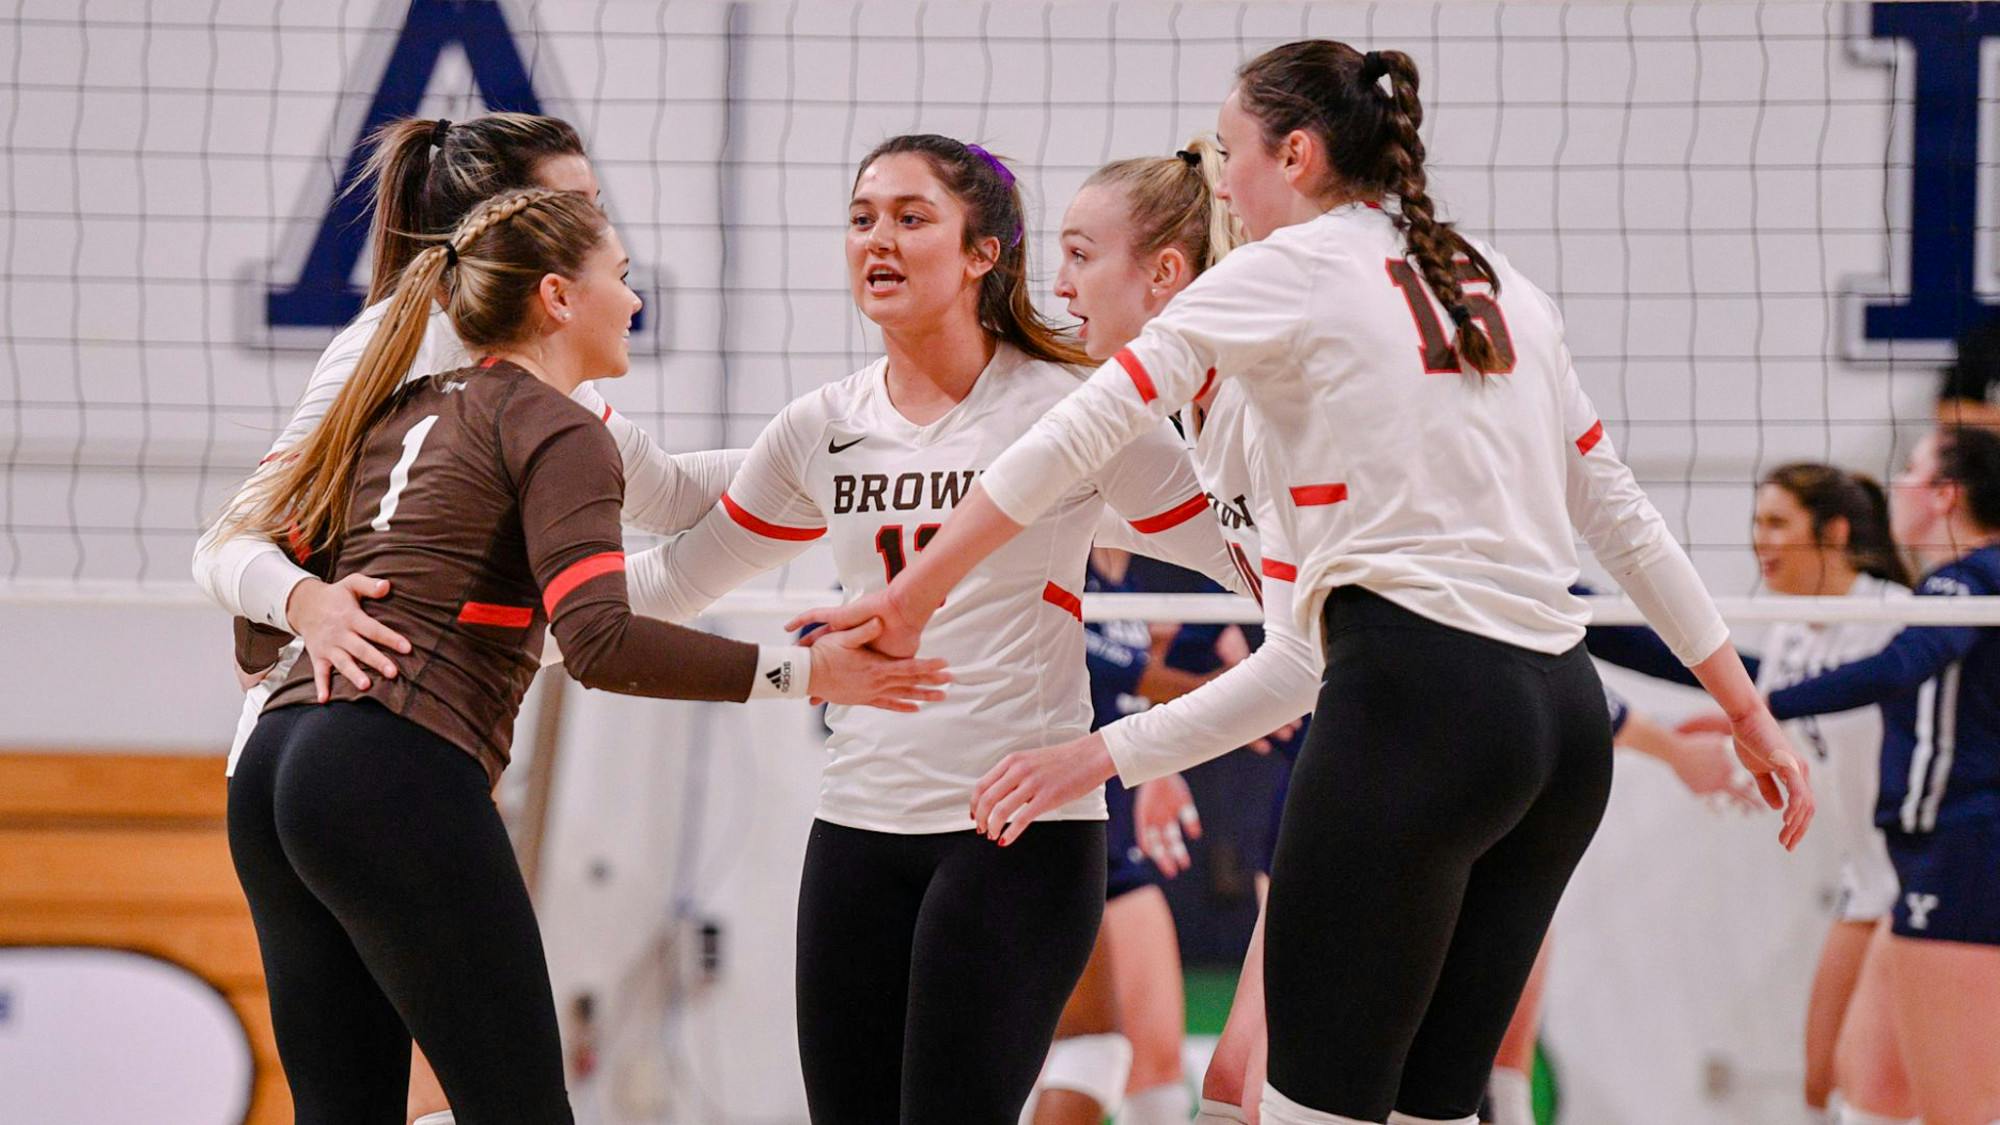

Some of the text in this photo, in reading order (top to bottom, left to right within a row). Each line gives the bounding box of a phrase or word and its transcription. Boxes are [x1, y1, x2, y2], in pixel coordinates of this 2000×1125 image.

[371, 415, 439, 531] 1
[833, 470, 985, 514] BROW
[1905, 892, 1938, 929] Y
